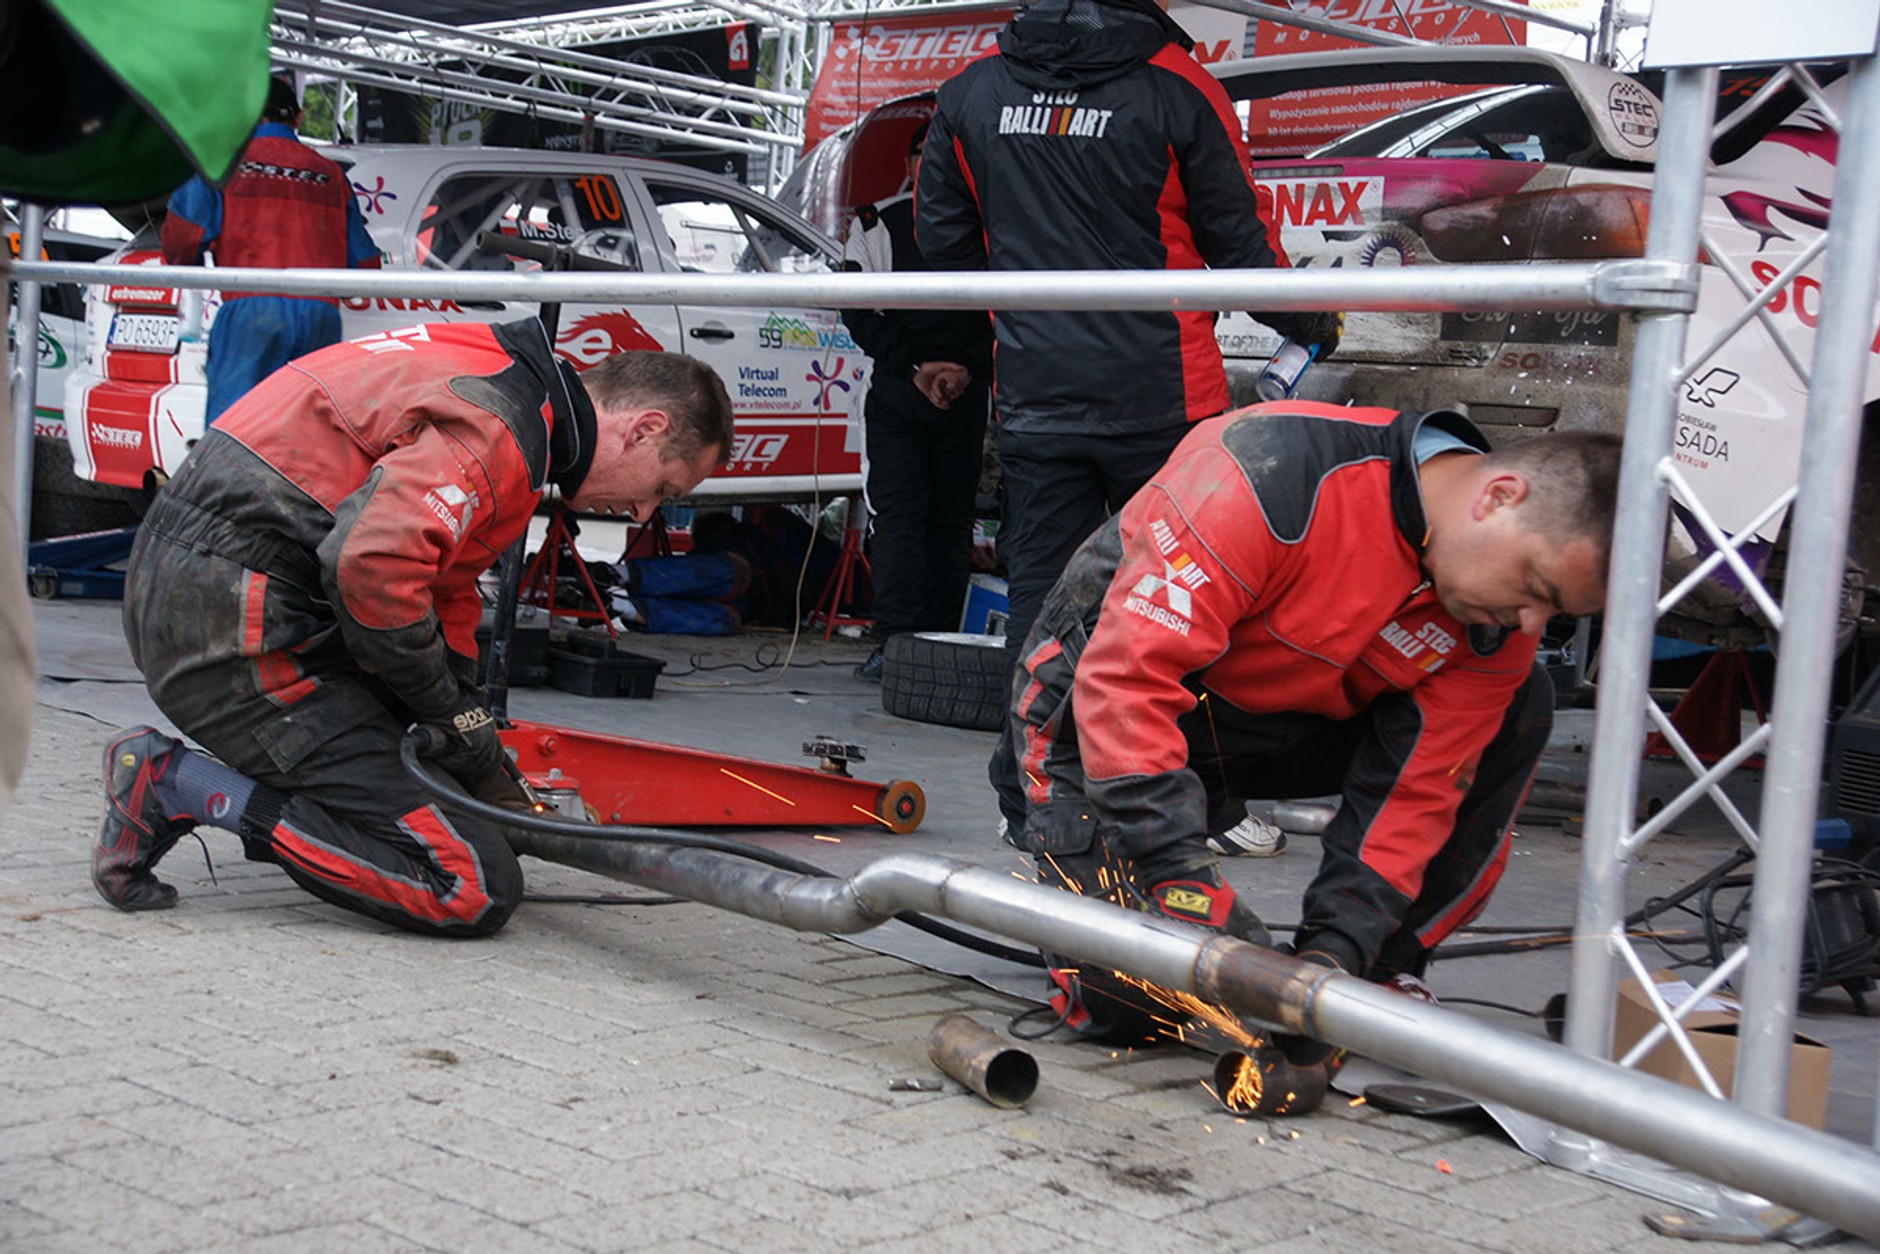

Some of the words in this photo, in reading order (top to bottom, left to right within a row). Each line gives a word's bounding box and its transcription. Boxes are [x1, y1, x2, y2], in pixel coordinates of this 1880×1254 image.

[1610, 98, 1653, 117] STEC
[575, 174, 622, 221] 10
[520, 219, 577, 241] M.Ste
[759, 327, 783, 349] 59
[738, 367, 779, 380] Virtual
[738, 383, 787, 397] Telecom
[1675, 426, 1728, 462] SADA
[1676, 452, 1709, 469] NTRUM
[1122, 594, 1192, 638] MITSUBISHI
[1415, 621, 1457, 655] STEC
